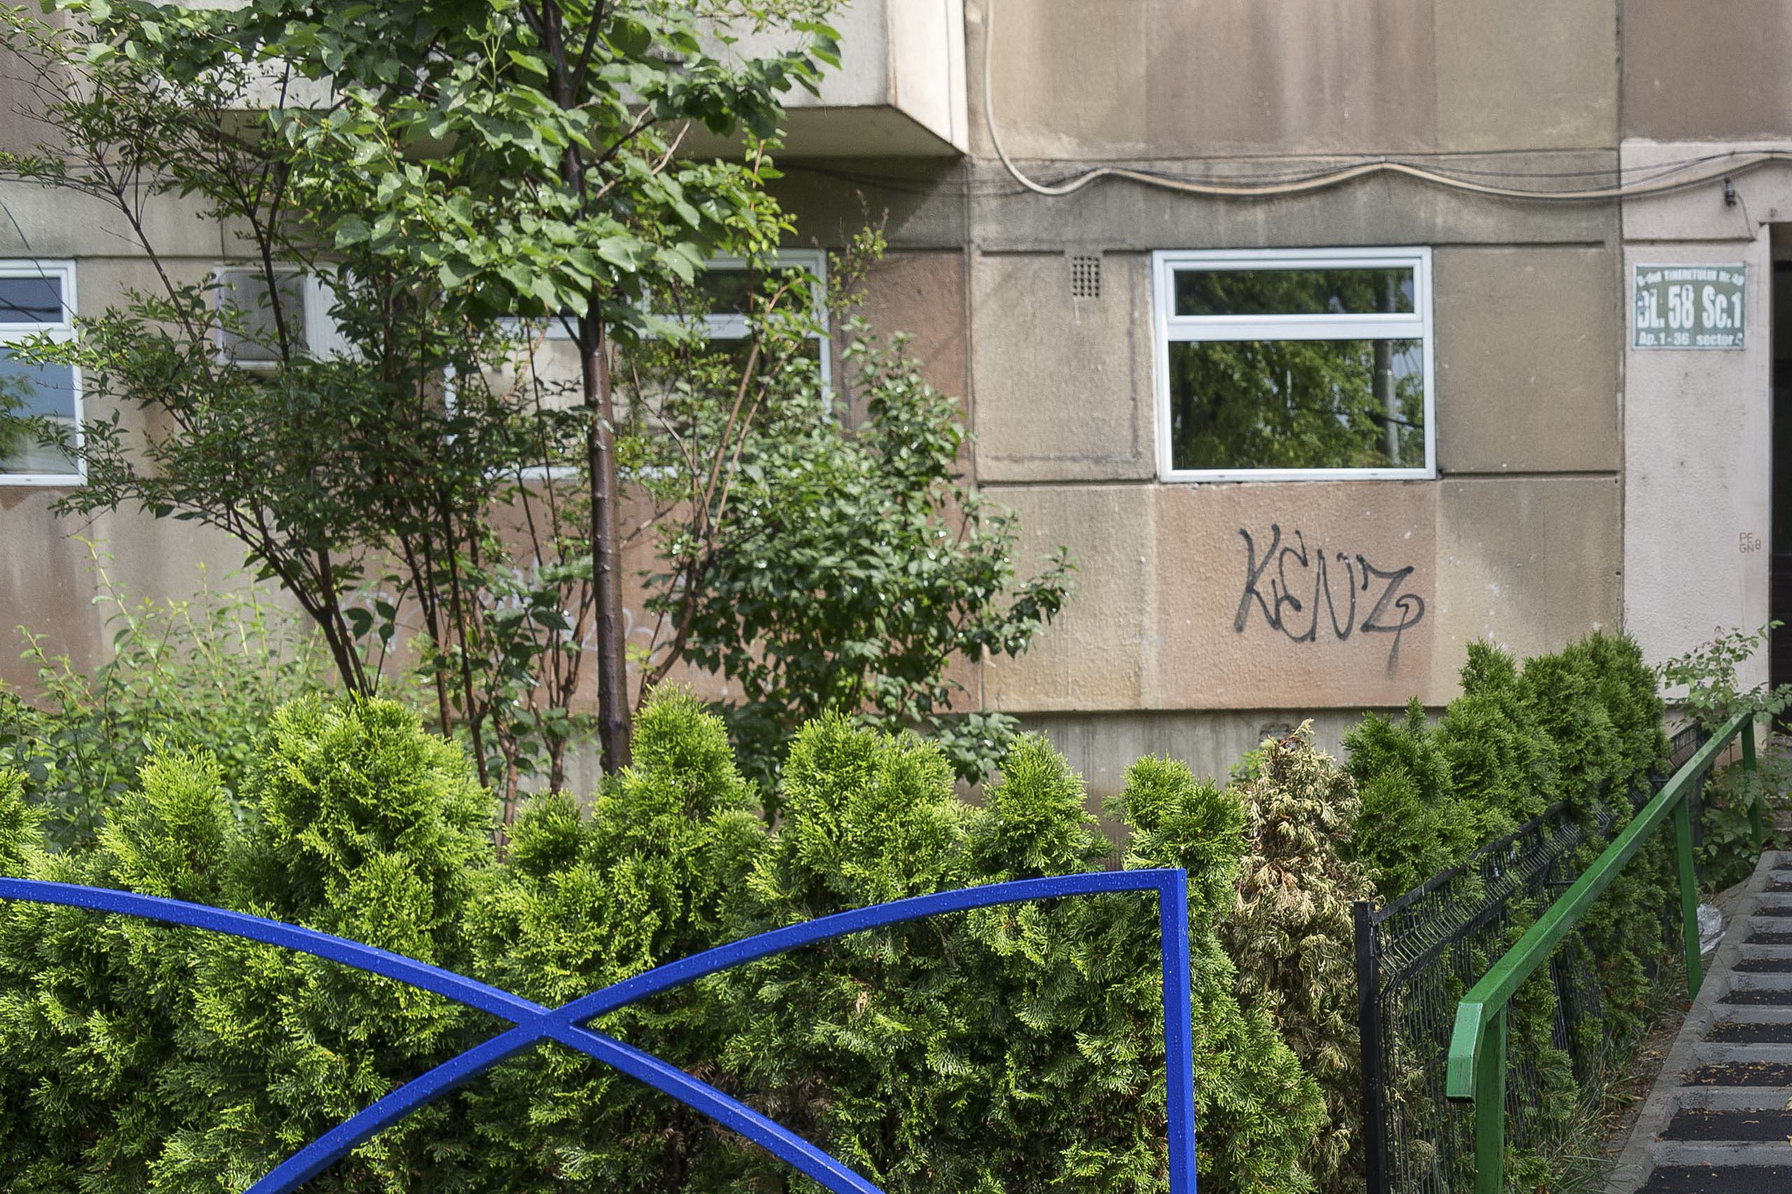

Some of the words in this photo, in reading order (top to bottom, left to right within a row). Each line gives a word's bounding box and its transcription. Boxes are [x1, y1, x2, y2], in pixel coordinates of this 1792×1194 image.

[1668, 284, 1695, 329] 58
[1639, 331, 1658, 346] Ap.
[1696, 333, 1734, 346] sector
